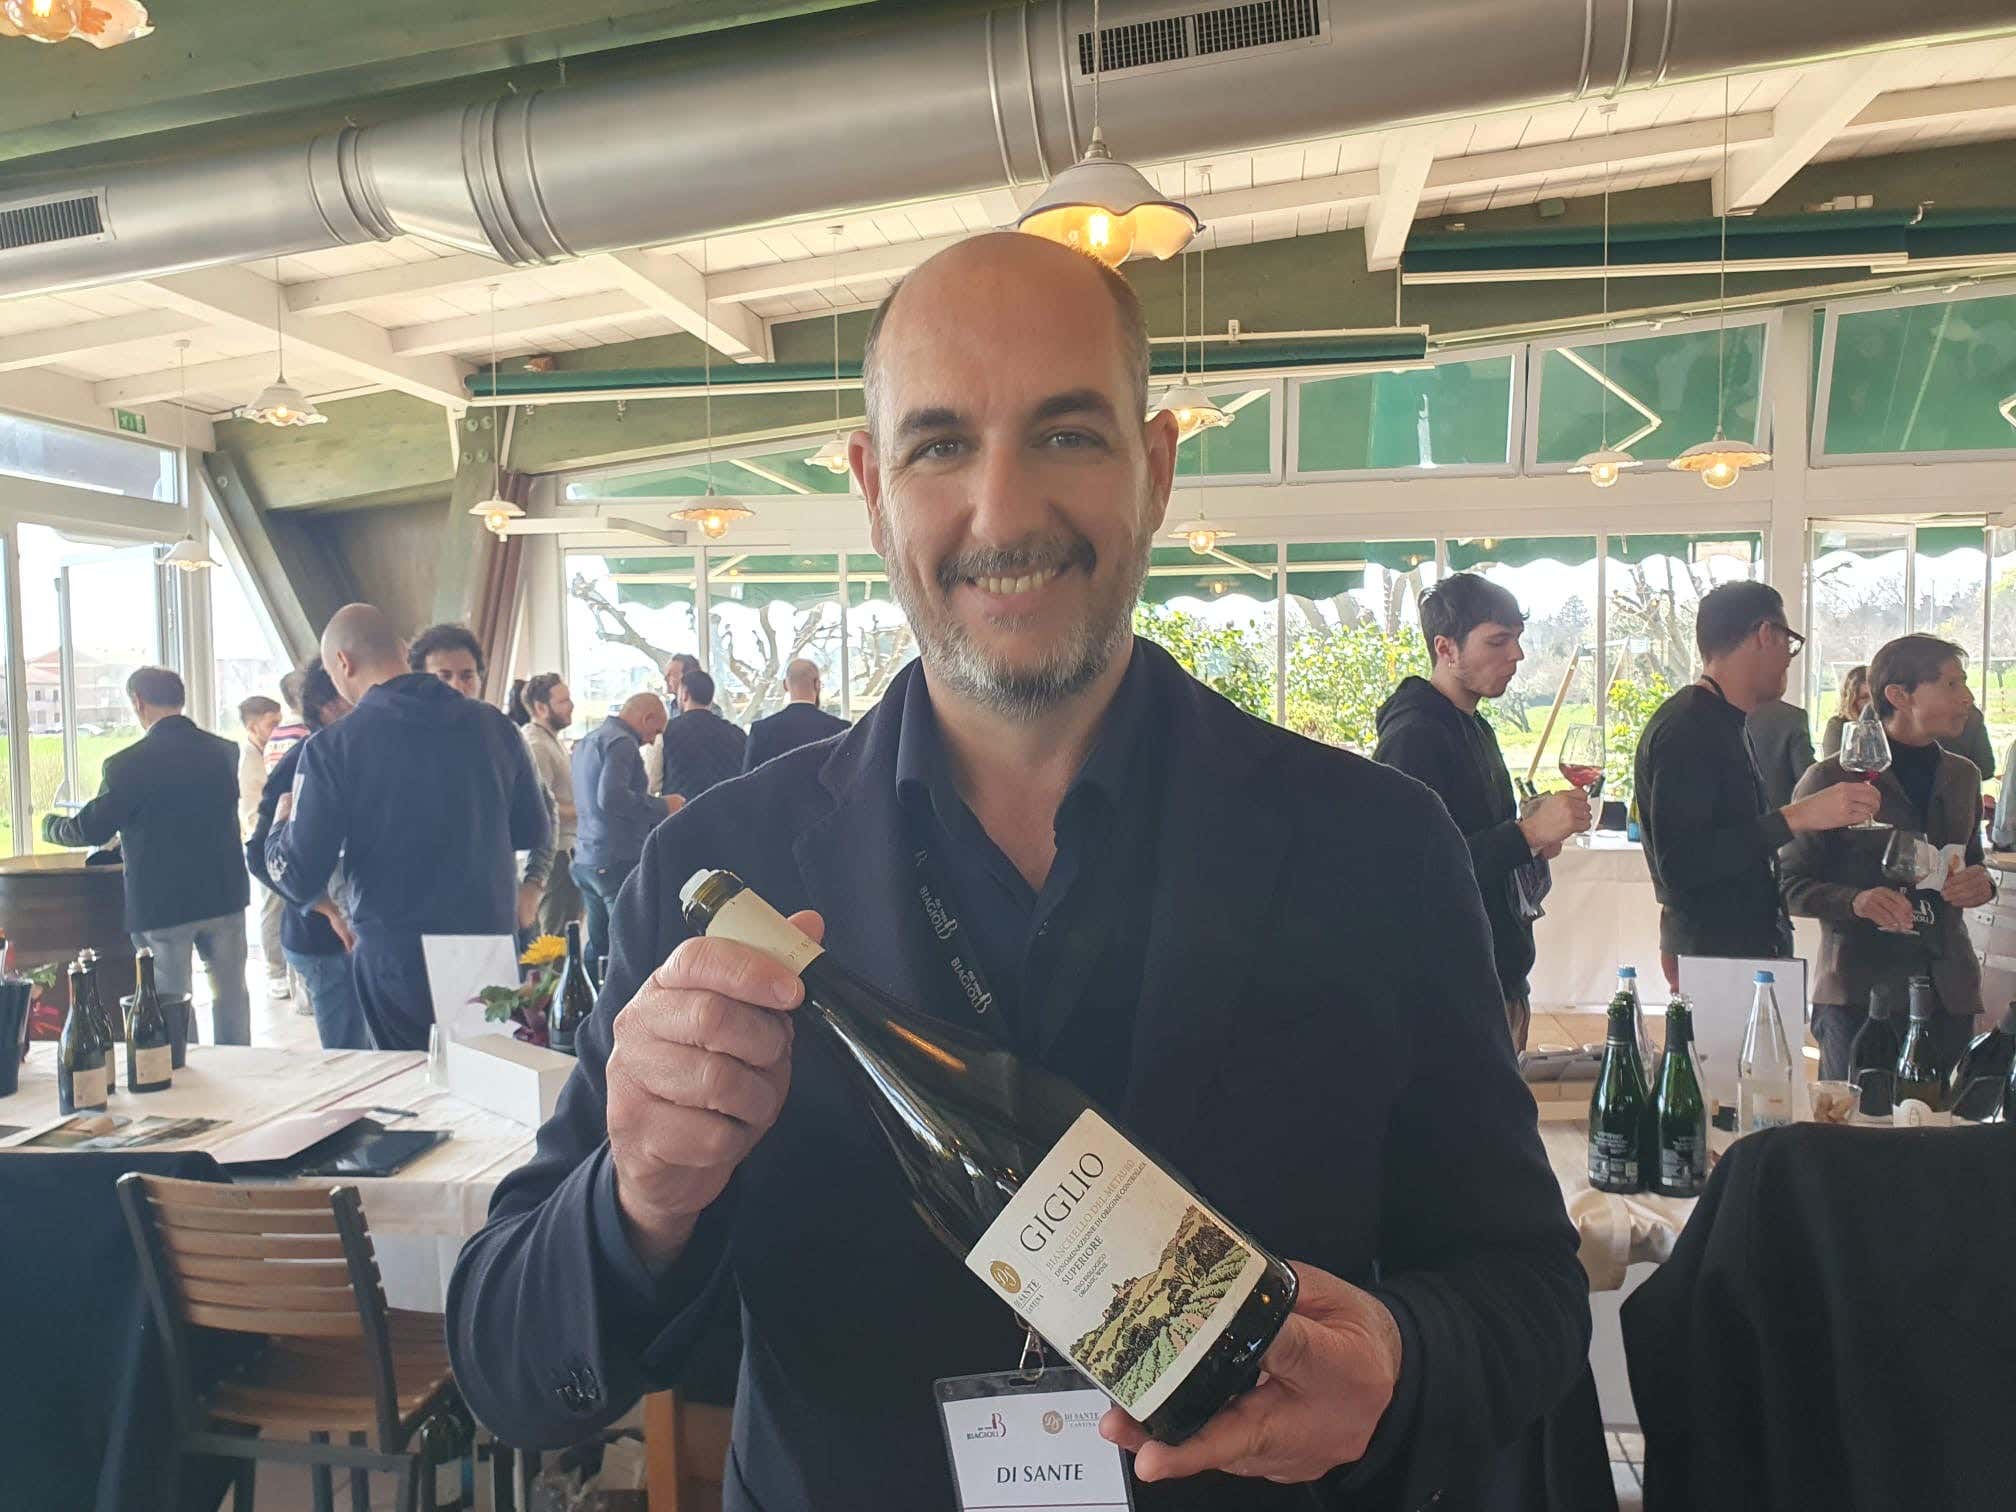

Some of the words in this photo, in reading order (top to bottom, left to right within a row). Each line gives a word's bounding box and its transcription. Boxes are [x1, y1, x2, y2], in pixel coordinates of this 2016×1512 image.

[920, 885, 944, 937] BIAGIOLI
[951, 956, 980, 1011] BIAGIOLI
[1020, 1152, 1104, 1252] GIGLIO
[1046, 1211, 1093, 1271] BIANCHELLO
[1091, 1196, 1108, 1216] DEL
[1104, 1159, 1136, 1198] METAURO
[1054, 1224, 1098, 1278] DENOMINAZIONE
[1101, 1194, 1122, 1219] ORIGINE
[1119, 1162, 1148, 1196] CONTROLLATA
[1061, 1235, 1104, 1286] SUPERIORE
[1073, 1277, 1086, 1293] VINO
[1083, 1253, 1107, 1280] BIOLOGICO
[1078, 1275, 1098, 1298] ORGANIC
[1096, 1262, 1109, 1278] WINE
[1018, 1278, 1041, 1301] SANTE
[966, 1431, 999, 1440] BIAGIOLI
[1064, 1412, 1073, 1421] DI
[1074, 1411, 1099, 1420] SANTE
[997, 1466, 1017, 1483] DI
[1023, 1463, 1084, 1483] SANTE
